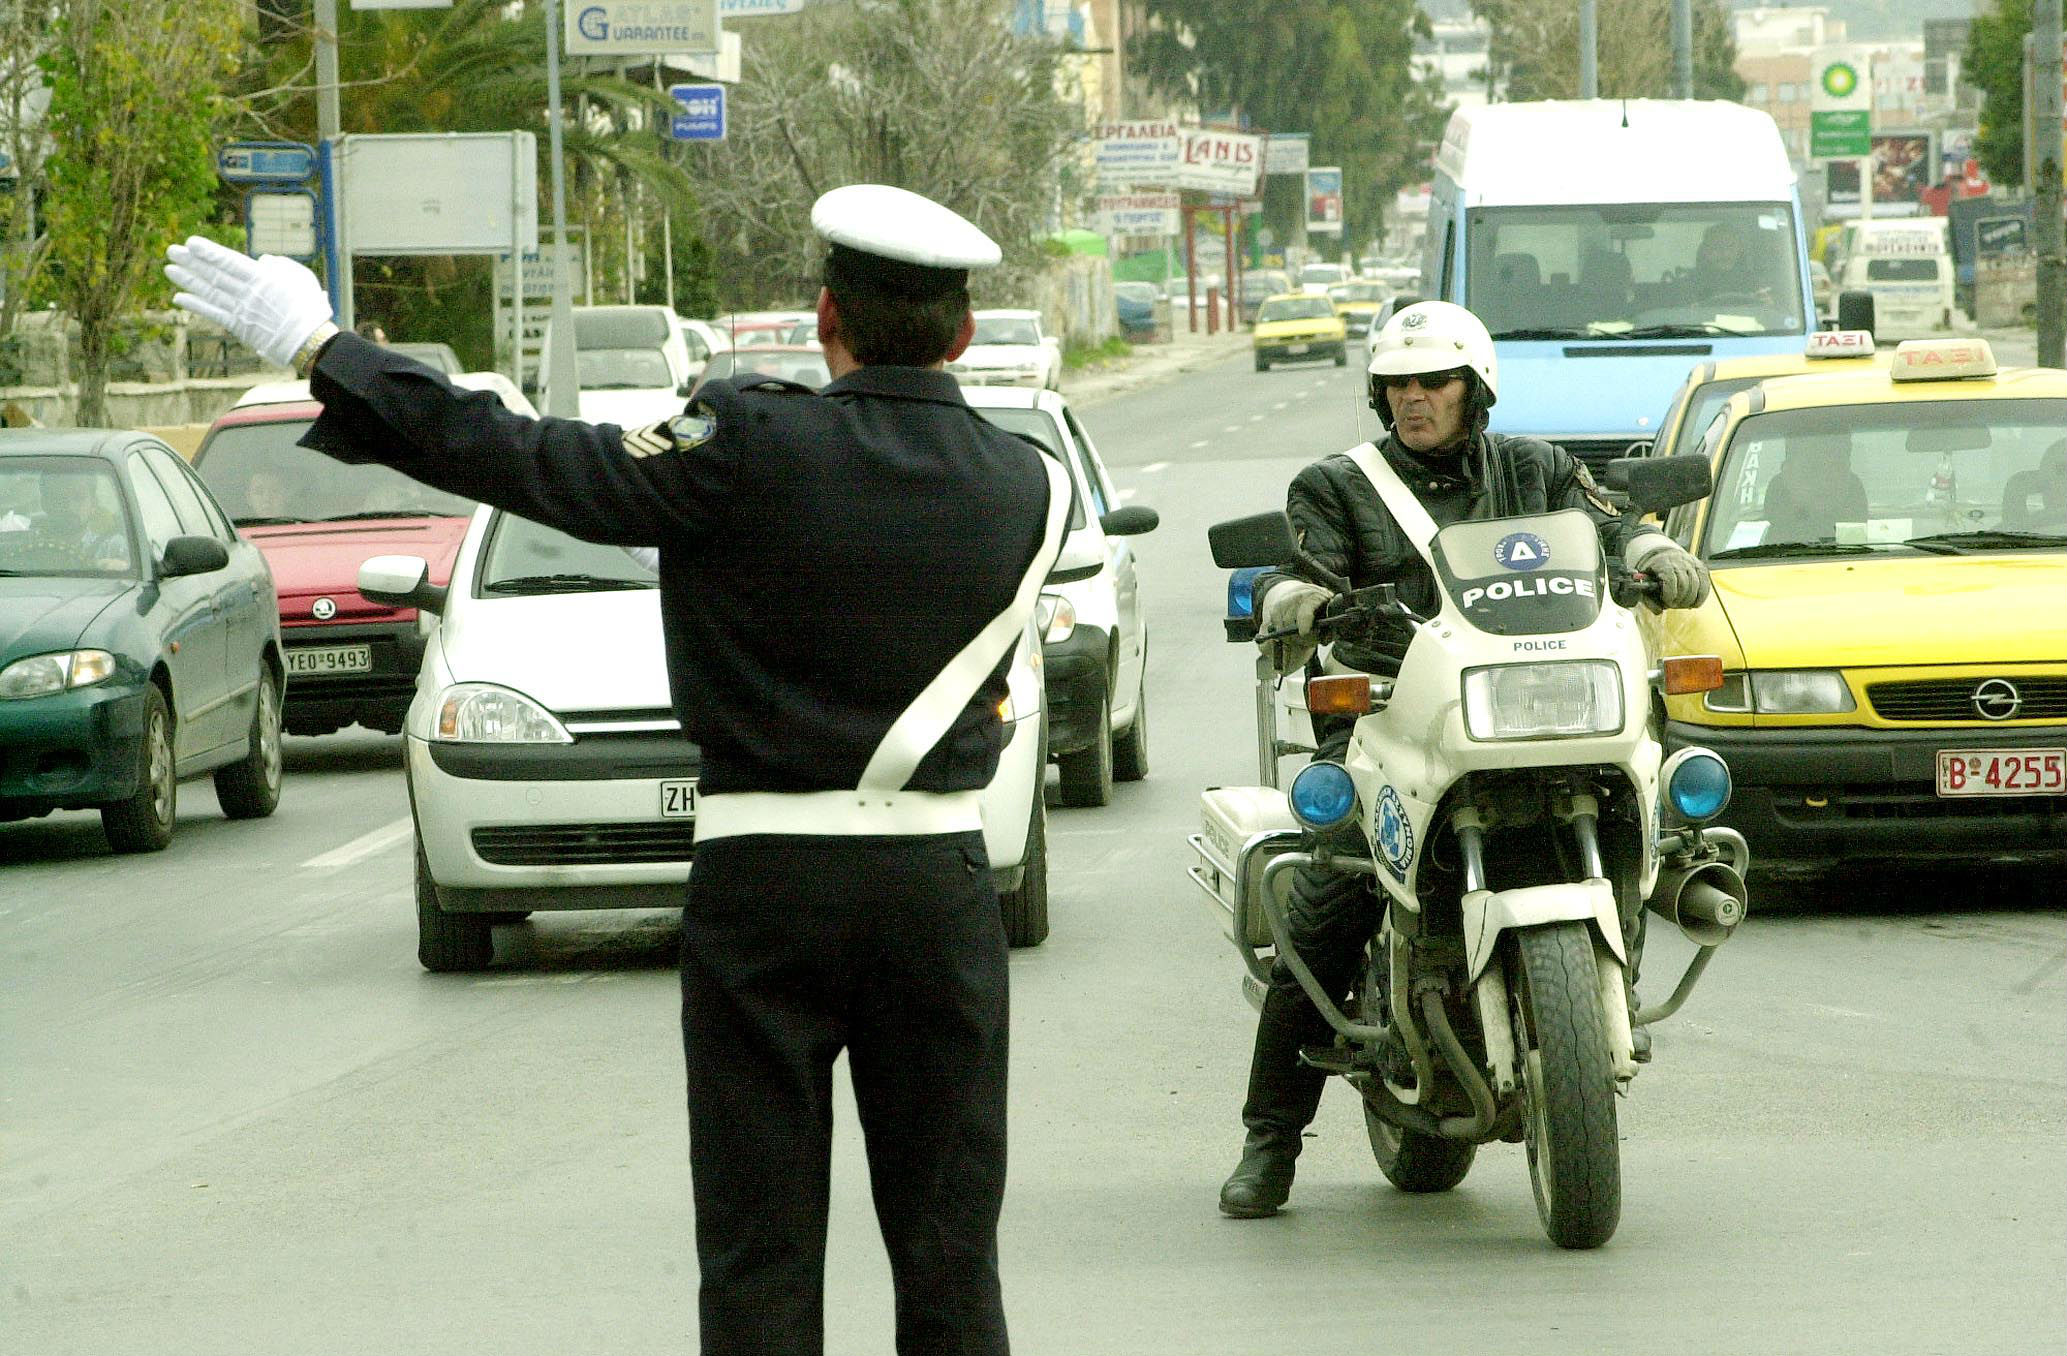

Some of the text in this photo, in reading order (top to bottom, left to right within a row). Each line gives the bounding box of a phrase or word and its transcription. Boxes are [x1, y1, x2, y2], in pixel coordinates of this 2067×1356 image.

[1184, 136, 1254, 164] LANIS
[1813, 334, 1864, 347] ΤΑΞΙ
[1899, 347, 1985, 366] ΤΑΞΙ
[1462, 576, 1596, 609] POLICE
[1513, 639, 1568, 652] POLICE
